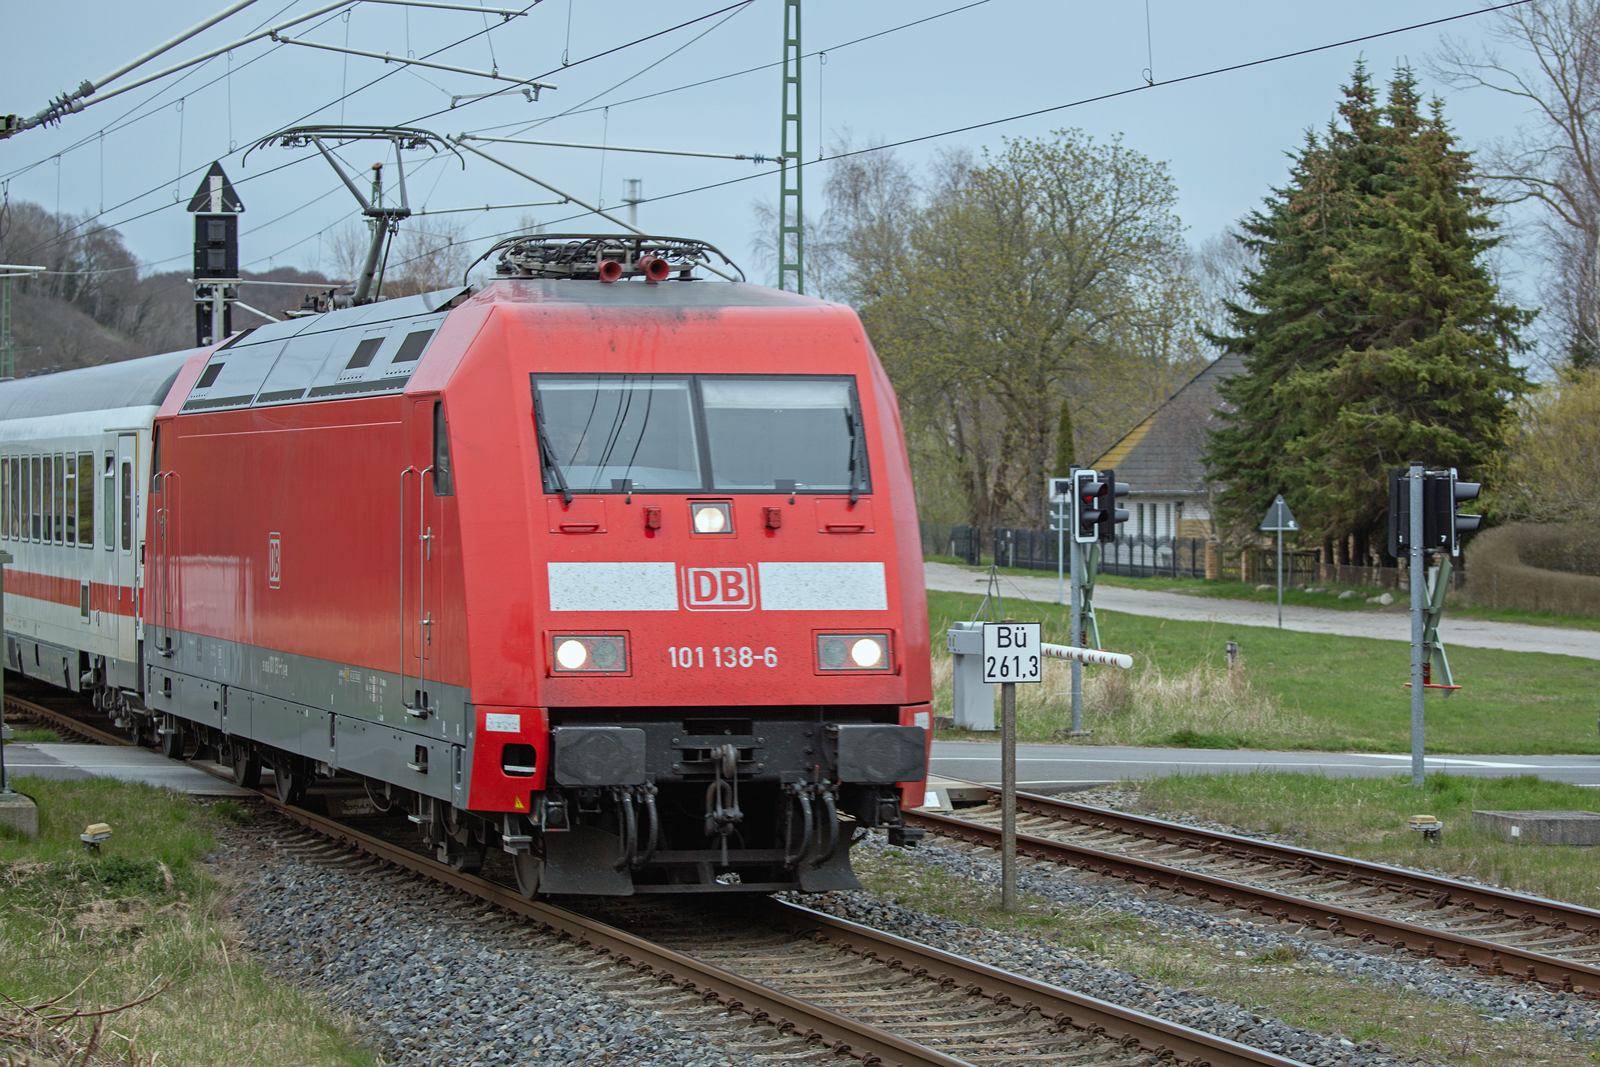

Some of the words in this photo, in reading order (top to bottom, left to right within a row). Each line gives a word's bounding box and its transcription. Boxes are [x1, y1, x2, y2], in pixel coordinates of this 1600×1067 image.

[270, 542, 279, 578] DB
[692, 570, 746, 602] DB
[997, 626, 1027, 649] Bü
[668, 646, 704, 669] 101
[712, 646, 778, 669] 138-6
[986, 655, 1038, 679] 261,3
